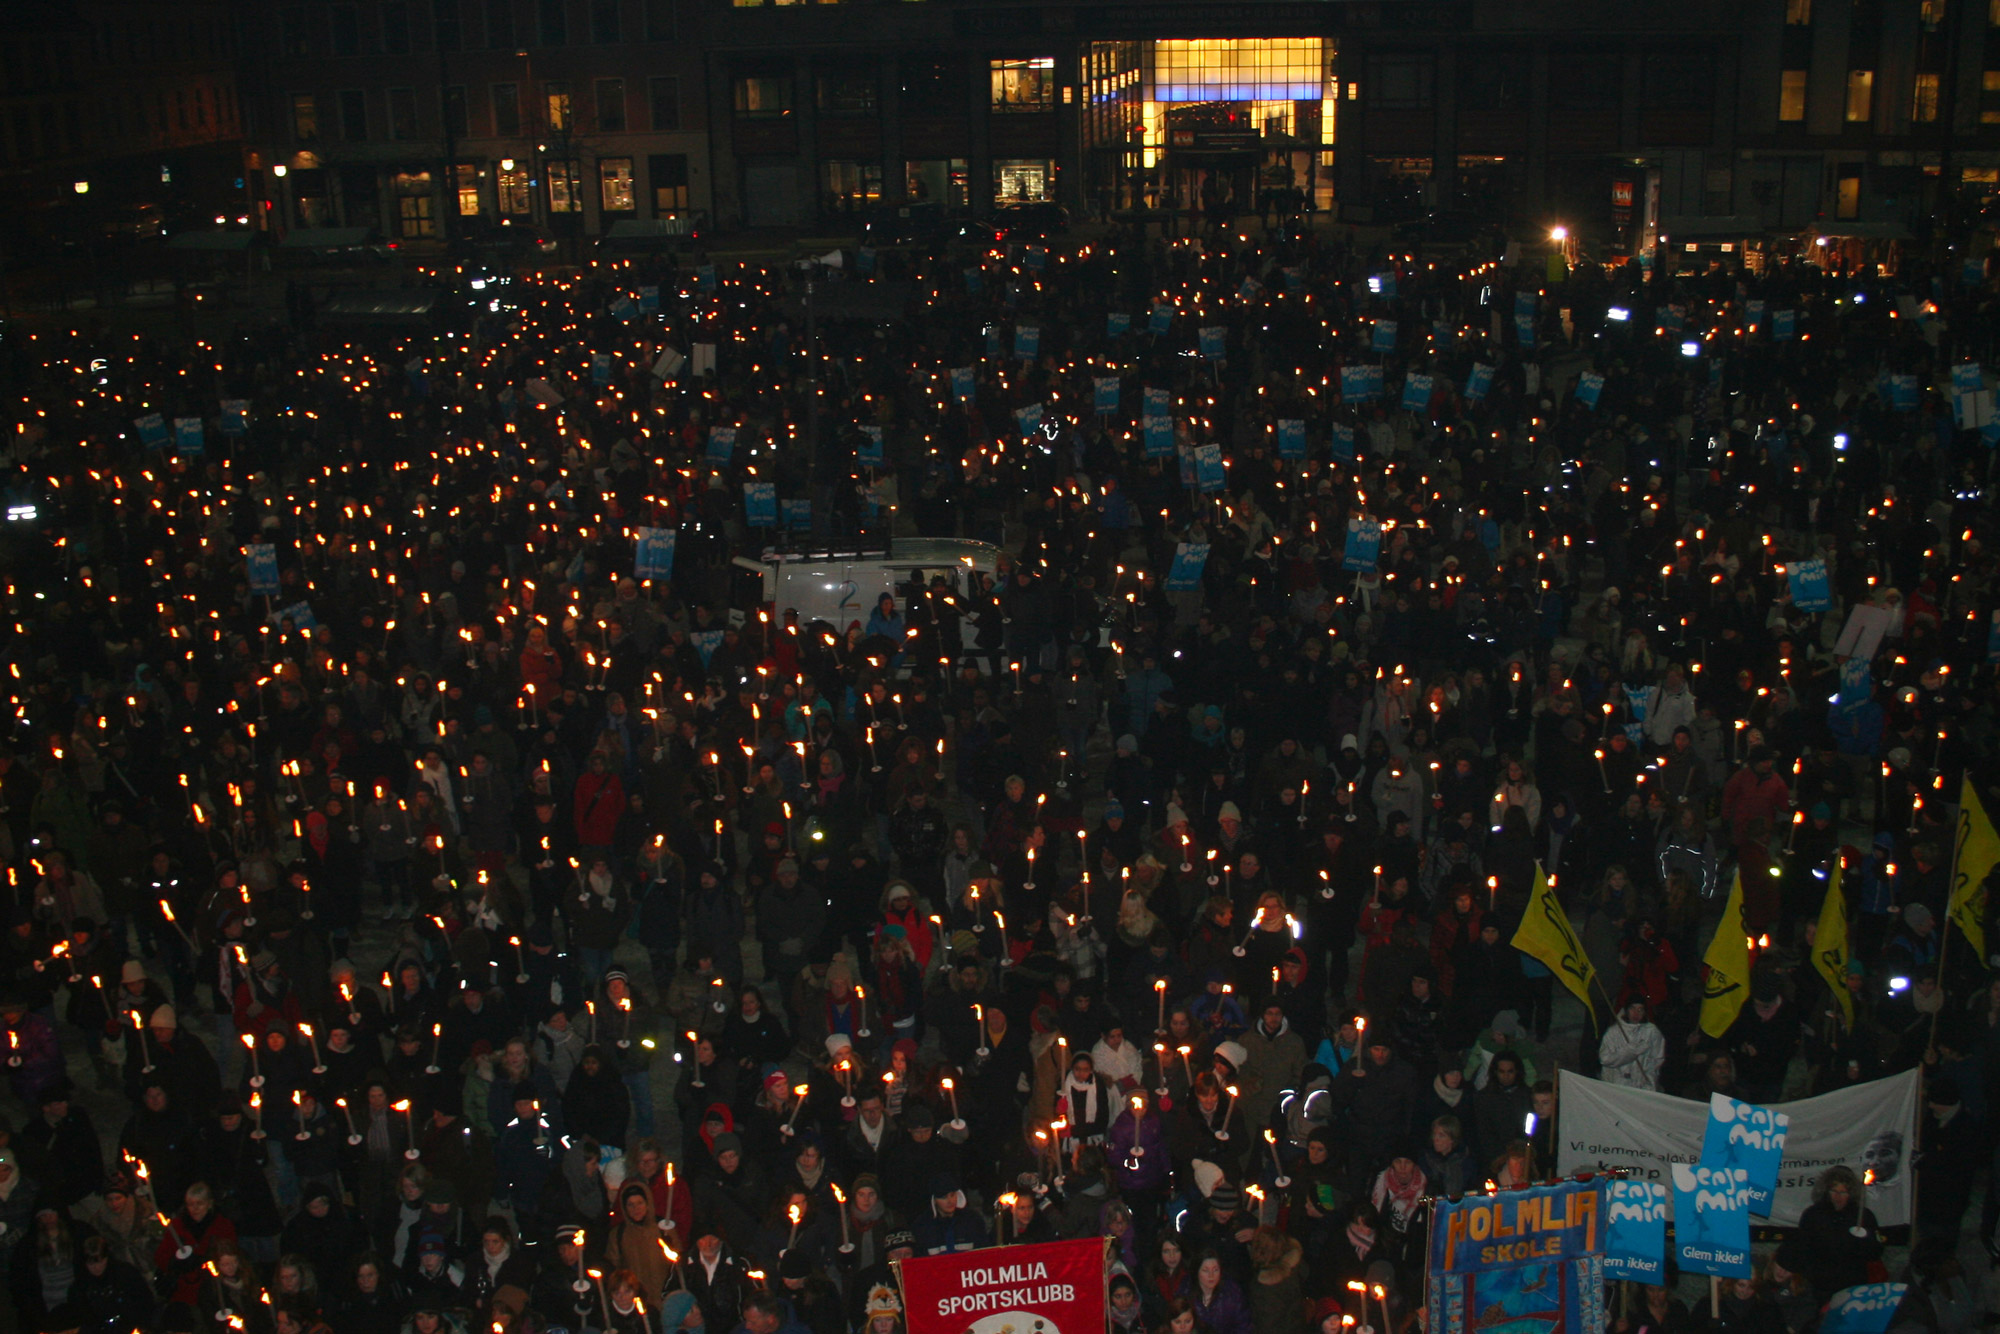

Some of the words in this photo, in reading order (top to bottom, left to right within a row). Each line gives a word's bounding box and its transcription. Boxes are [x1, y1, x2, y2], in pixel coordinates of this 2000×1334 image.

[1570, 1141, 1585, 1151] Vi
[1588, 1144, 1653, 1158] glemmer
[1444, 1190, 1598, 1271] HOLMLIA
[1480, 1236, 1562, 1264] SKOLE
[1682, 1245, 1712, 1262] Glem
[1715, 1248, 1745, 1264] ikke!
[961, 1261, 1048, 1288] HOLMLIA
[1627, 1256, 1659, 1272] ikke!
[937, 1283, 1075, 1316] SPORTSKLUBB
